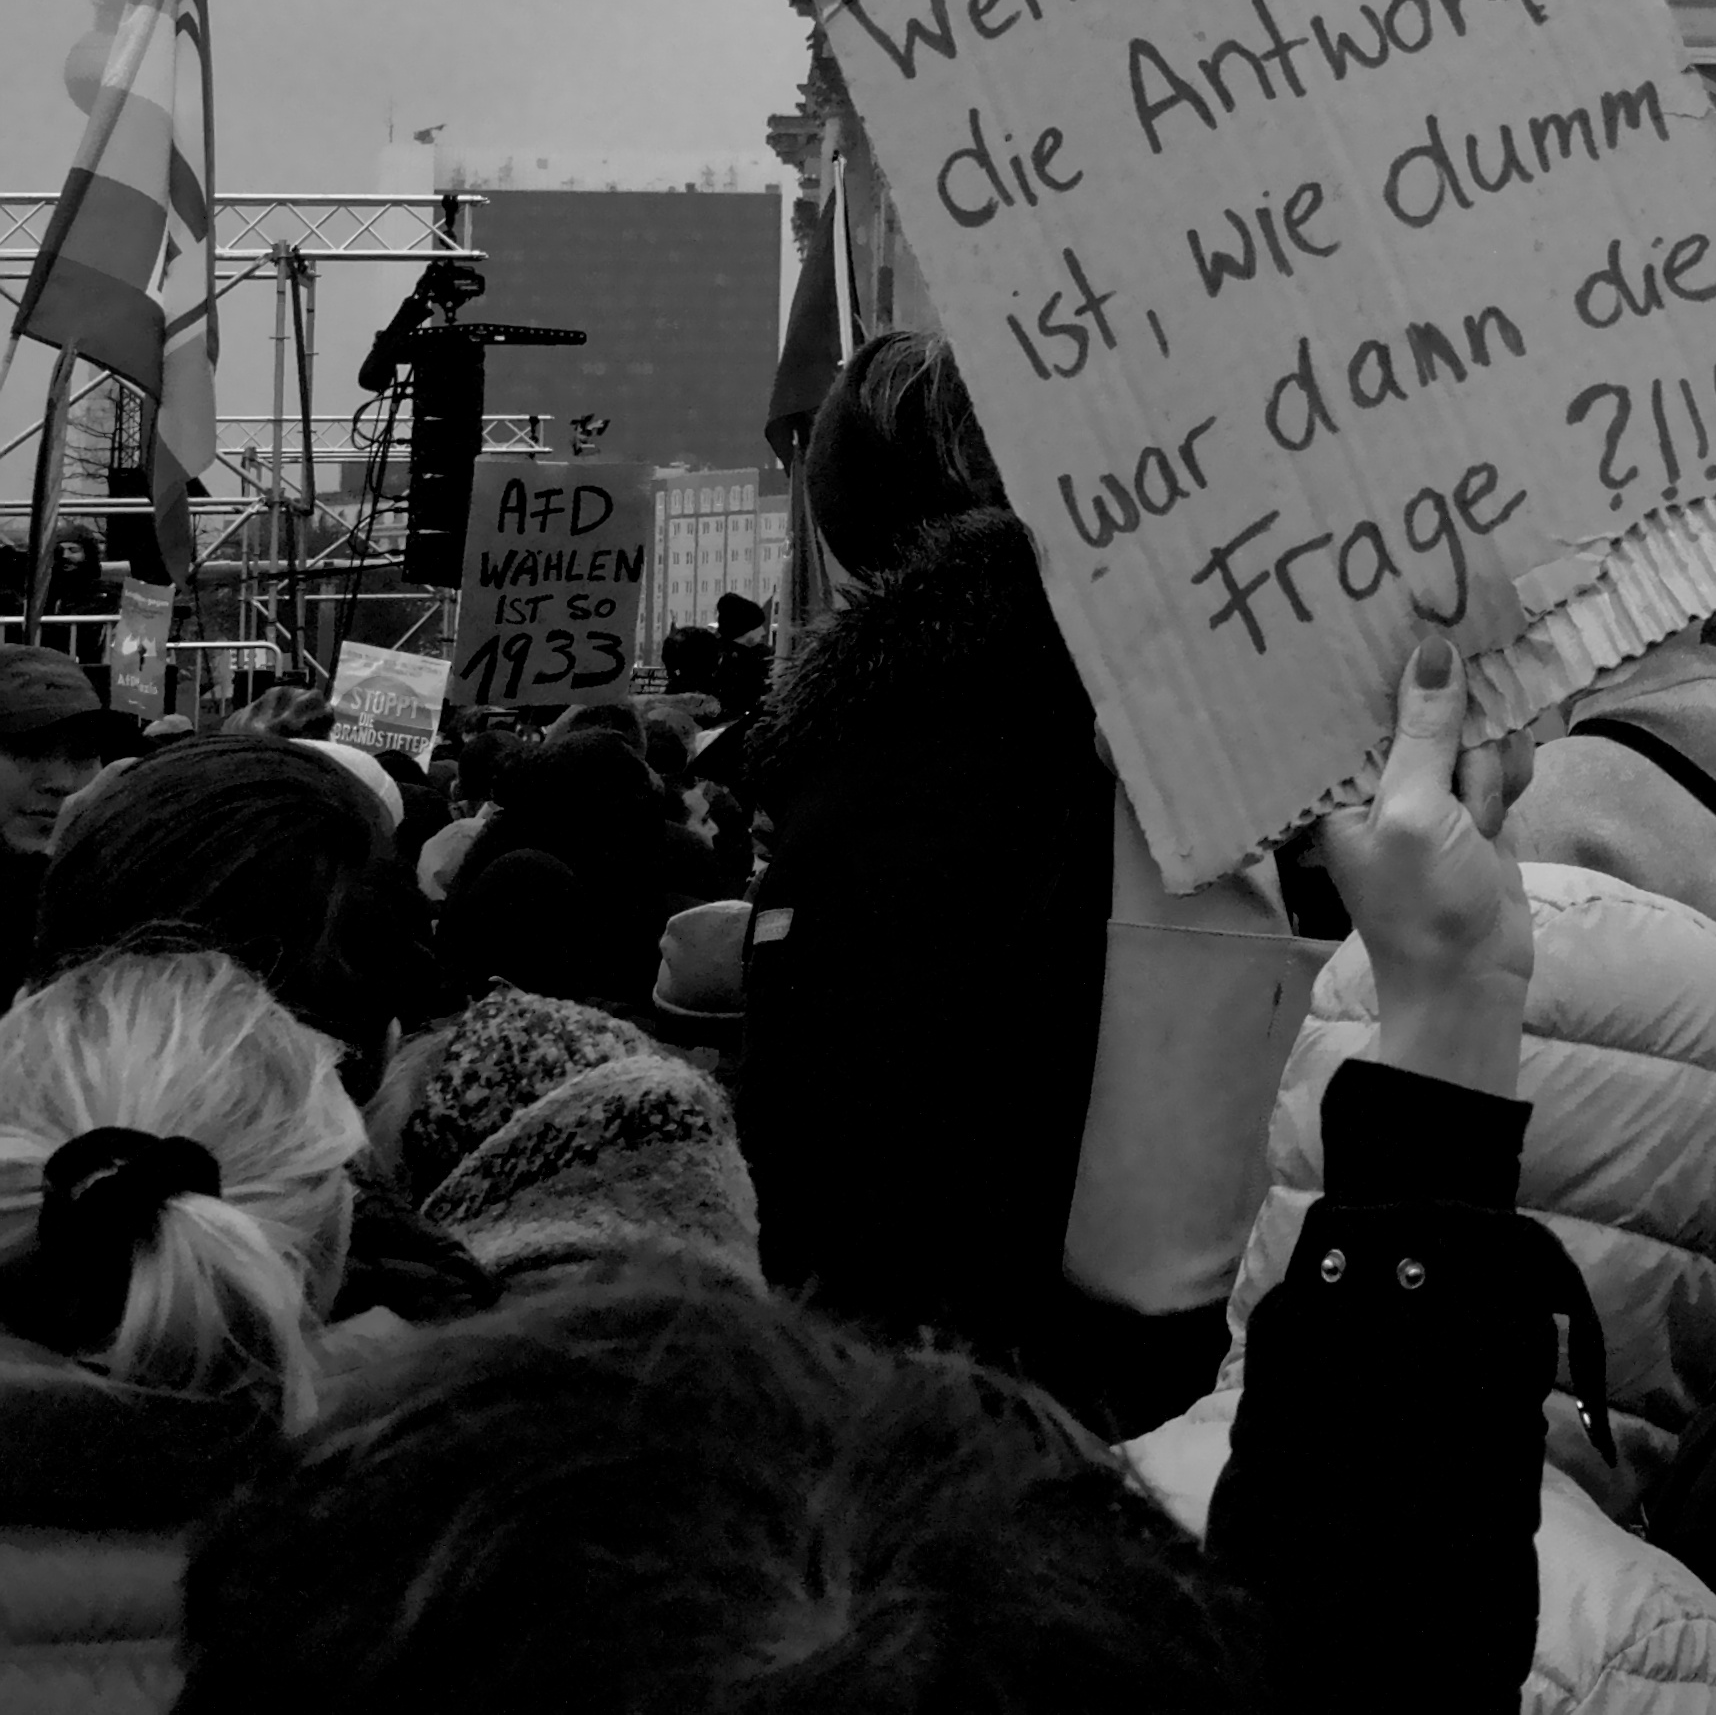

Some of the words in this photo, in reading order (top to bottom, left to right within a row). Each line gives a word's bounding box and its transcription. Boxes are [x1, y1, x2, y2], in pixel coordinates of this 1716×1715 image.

[936, 107, 1085, 229] die
[1188, 180, 1340, 296] wie
[1383, 79, 1667, 229] dumm
[1057, 416, 1219, 549] war
[1264, 302, 1526, 452] dann
[480, 545, 644, 589] WÄHLEN
[495, 594, 554, 625] IST
[567, 594, 616, 620] SO
[460, 629, 625, 705] 1933
